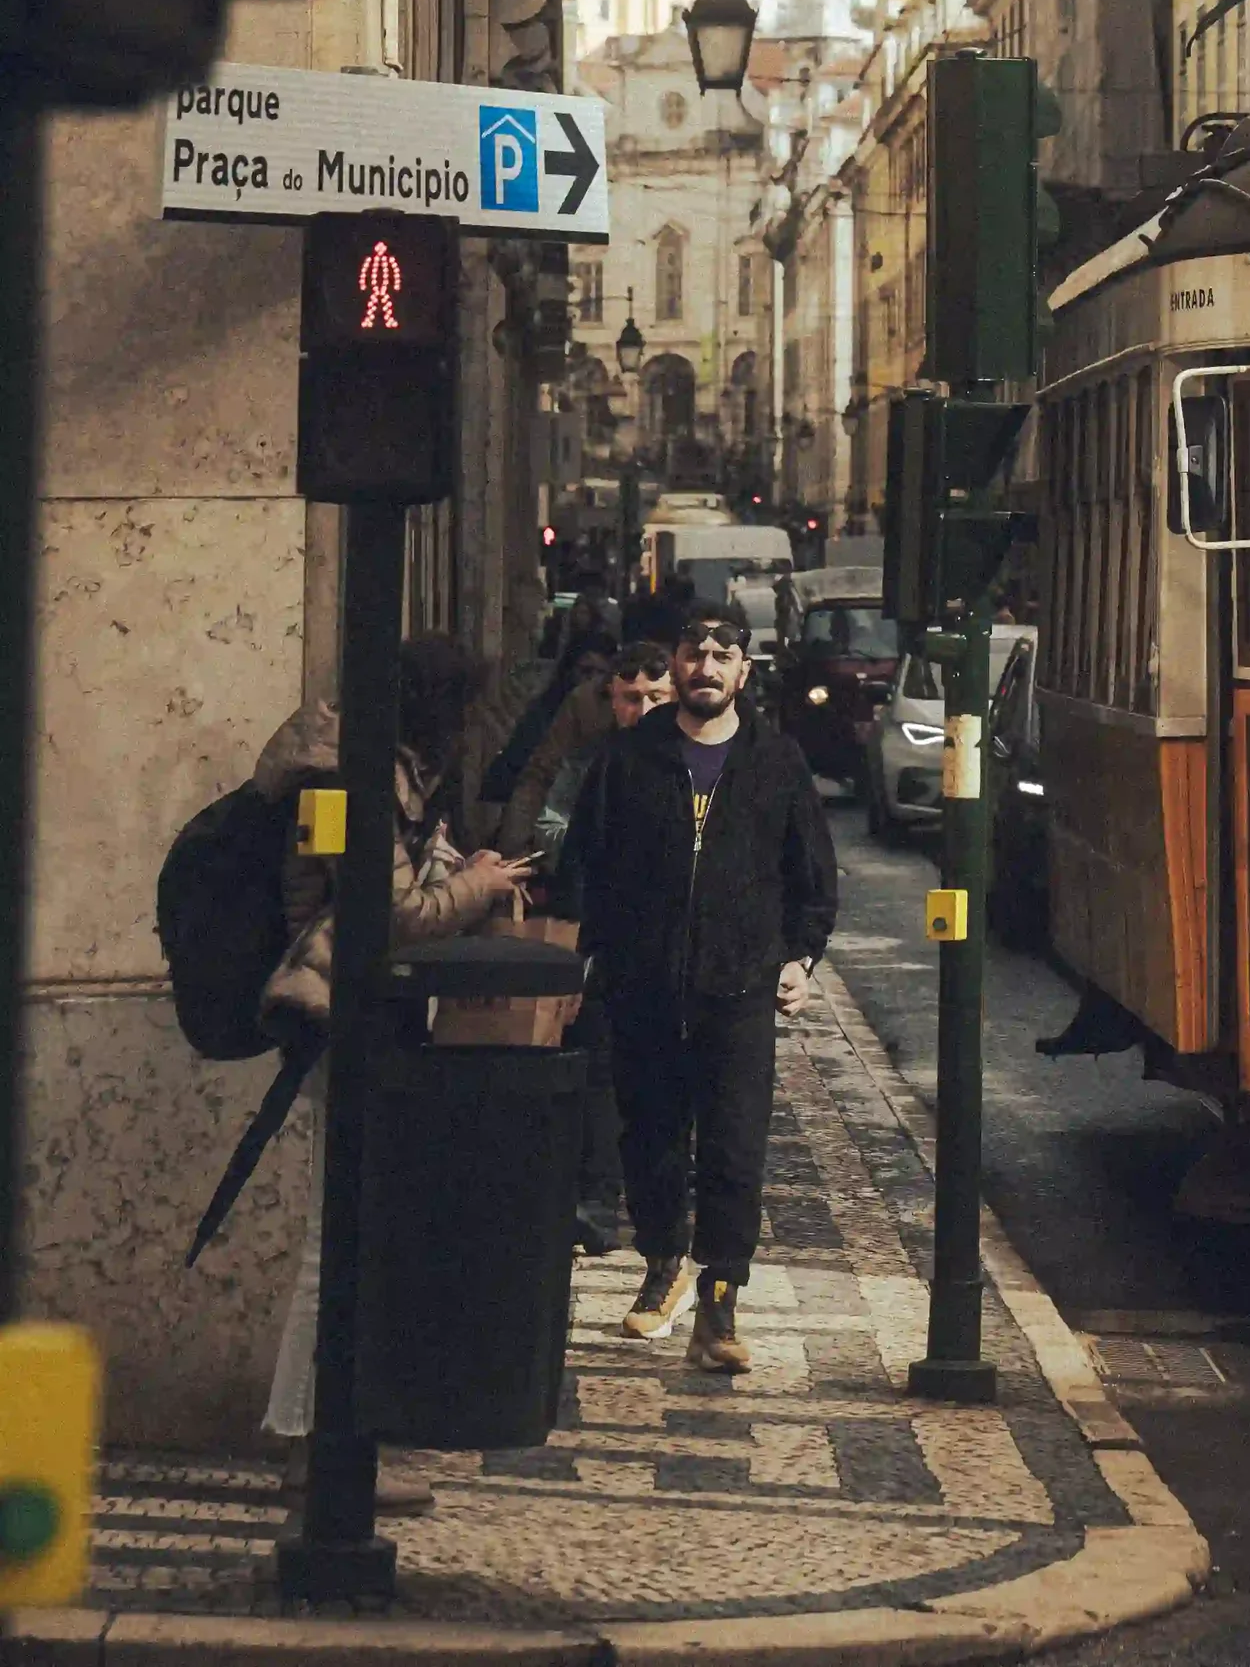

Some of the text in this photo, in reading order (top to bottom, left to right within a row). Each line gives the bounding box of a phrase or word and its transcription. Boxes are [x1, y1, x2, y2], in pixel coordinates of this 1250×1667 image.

[176, 84, 280, 125] parque
[173, 138, 269, 201] Praça
[282, 168, 303, 191] do
[1170, 287, 1215, 312] ENTRADA
